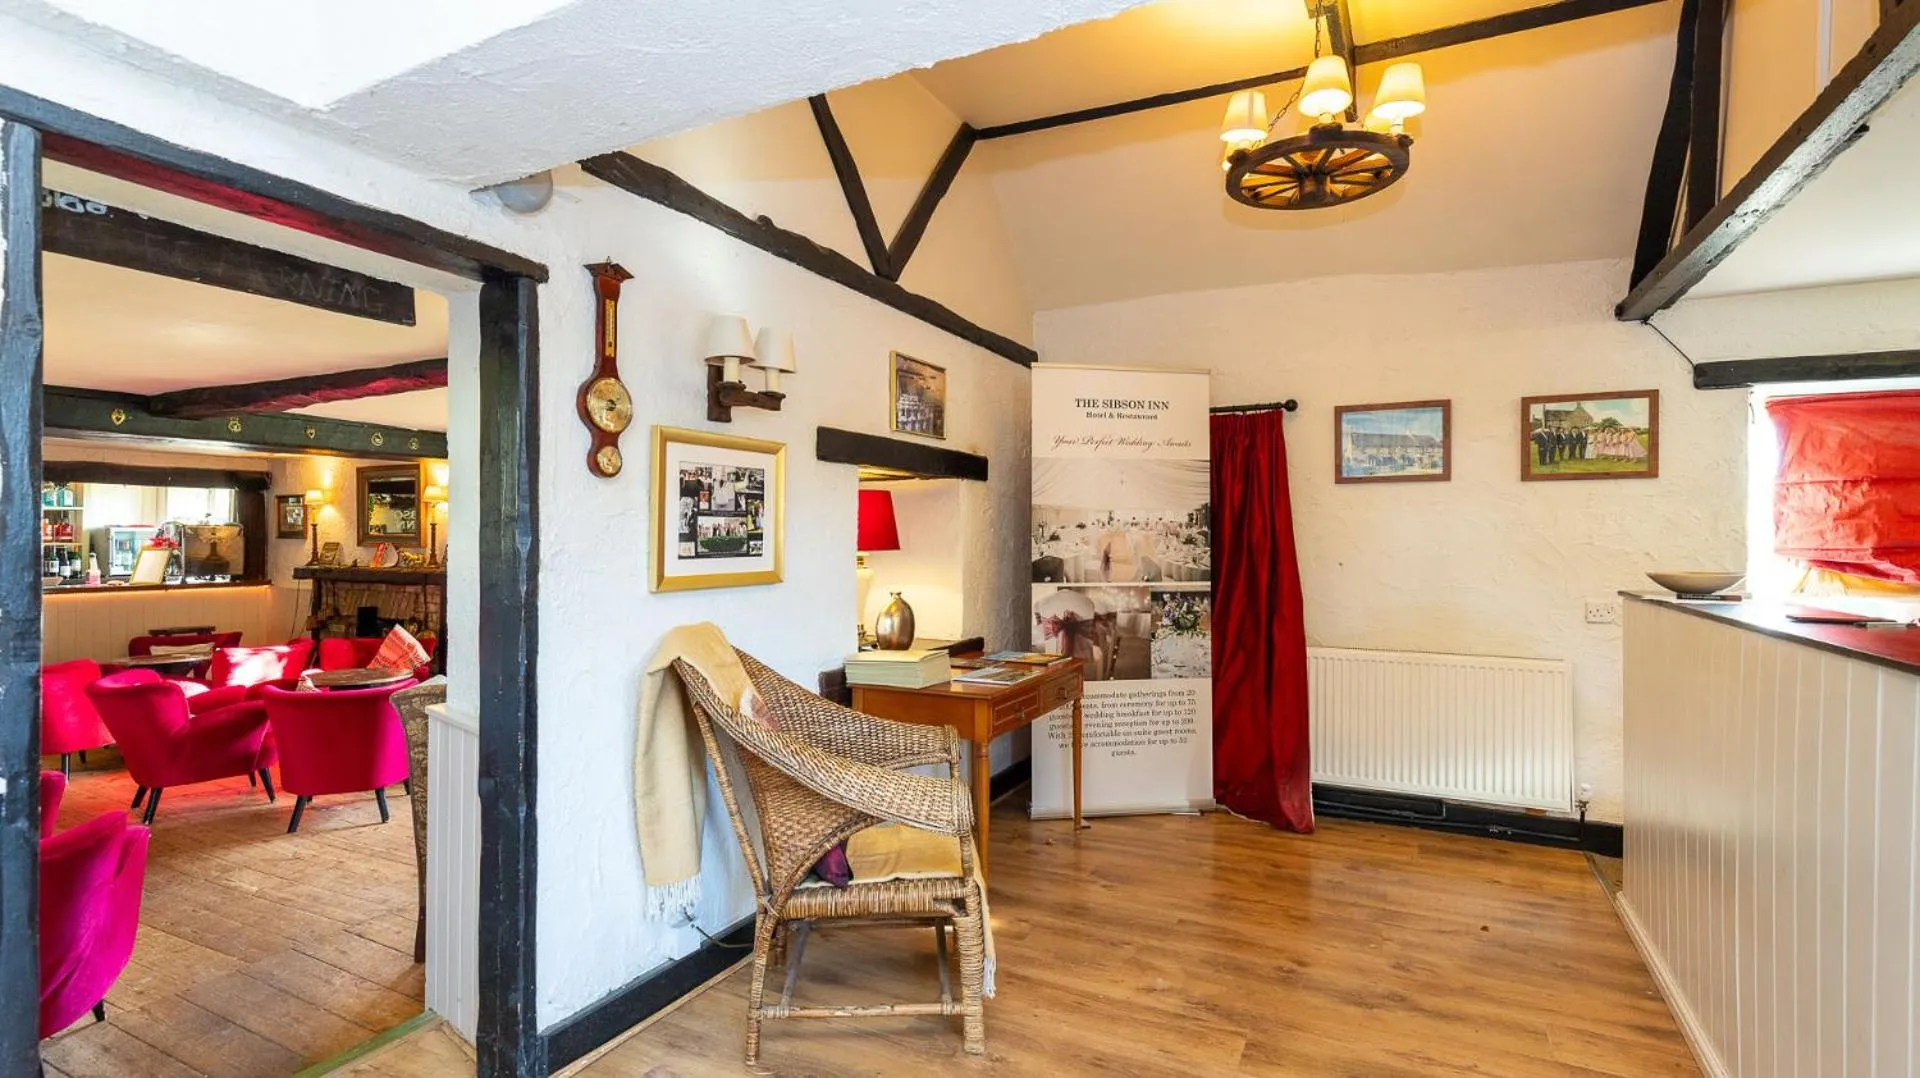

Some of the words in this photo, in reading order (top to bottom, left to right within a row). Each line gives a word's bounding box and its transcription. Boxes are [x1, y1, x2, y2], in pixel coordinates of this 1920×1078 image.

[1075, 398, 1099, 408] THE
[1102, 399, 1144, 409] SIBSON
[1148, 400, 1169, 410] INN
[1086, 411, 1107, 419] Hotel
[1052, 435, 1077, 451] Your
[1079, 433, 1113, 452] Perfect
